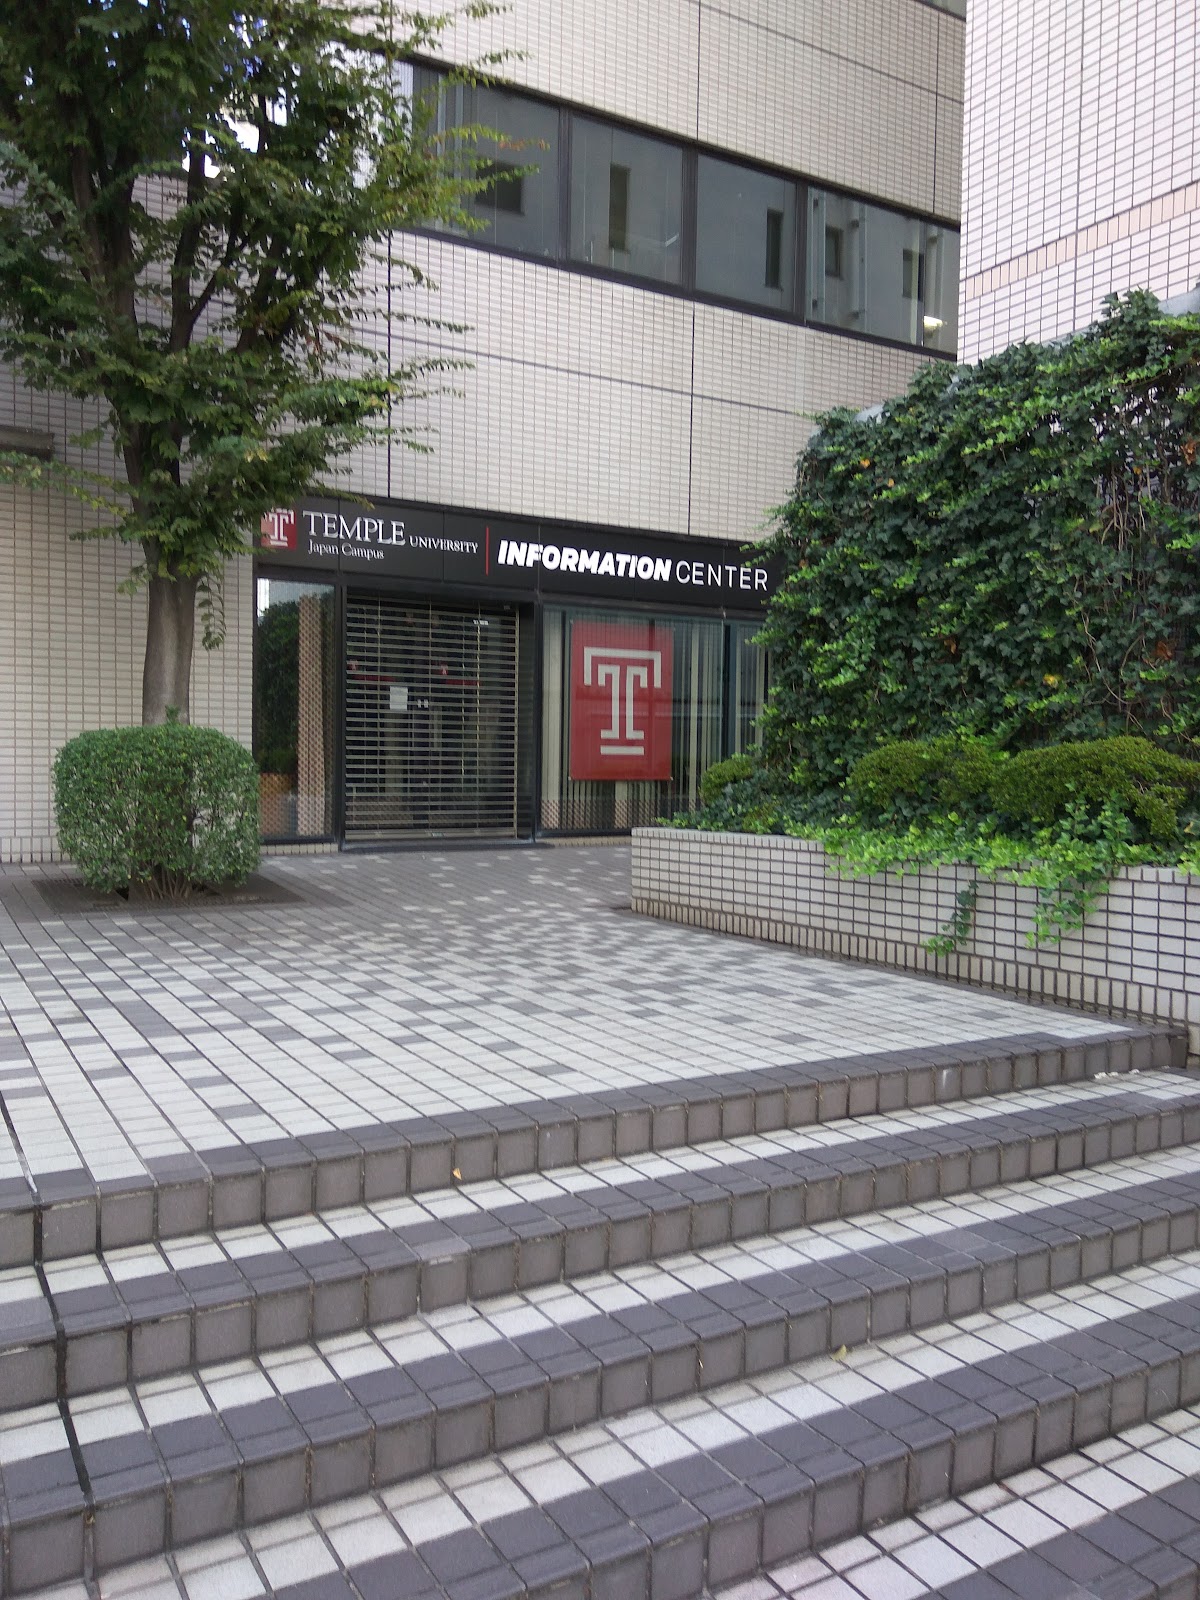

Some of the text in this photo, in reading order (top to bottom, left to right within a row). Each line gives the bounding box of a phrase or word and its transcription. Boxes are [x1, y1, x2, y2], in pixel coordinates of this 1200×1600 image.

[302, 510, 479, 554] TEMPLE UNIVERSITY
[308, 539, 385, 561] Japan Campus
[498, 539, 768, 591] INFORMATION CENTER
